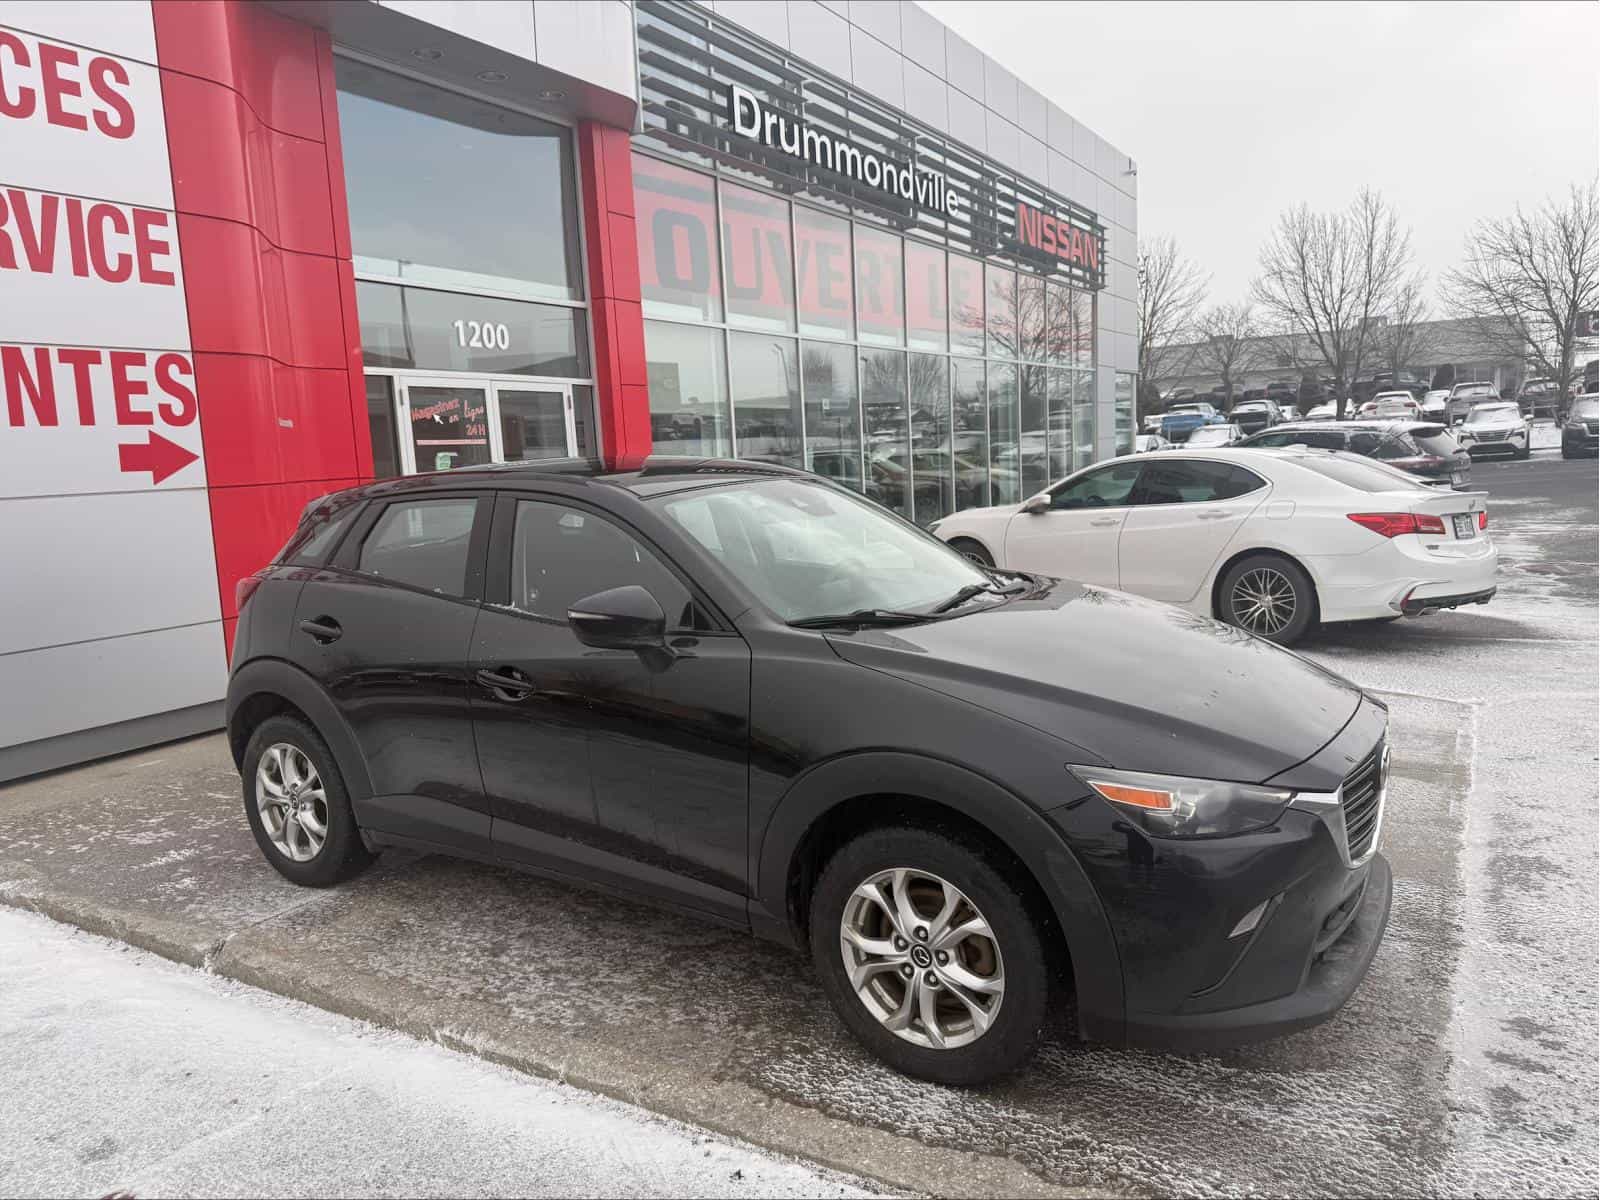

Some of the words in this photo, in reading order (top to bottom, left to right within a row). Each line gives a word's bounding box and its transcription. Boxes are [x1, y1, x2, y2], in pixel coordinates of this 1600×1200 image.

[0, 31, 135, 139] CES
[732, 84, 960, 216] Drummondville
[653, 208, 908, 318] OUVERT
[1018, 202, 1098, 271] NISSAN
[454, 319, 509, 350] 1200
[0, 346, 197, 427] NTES
